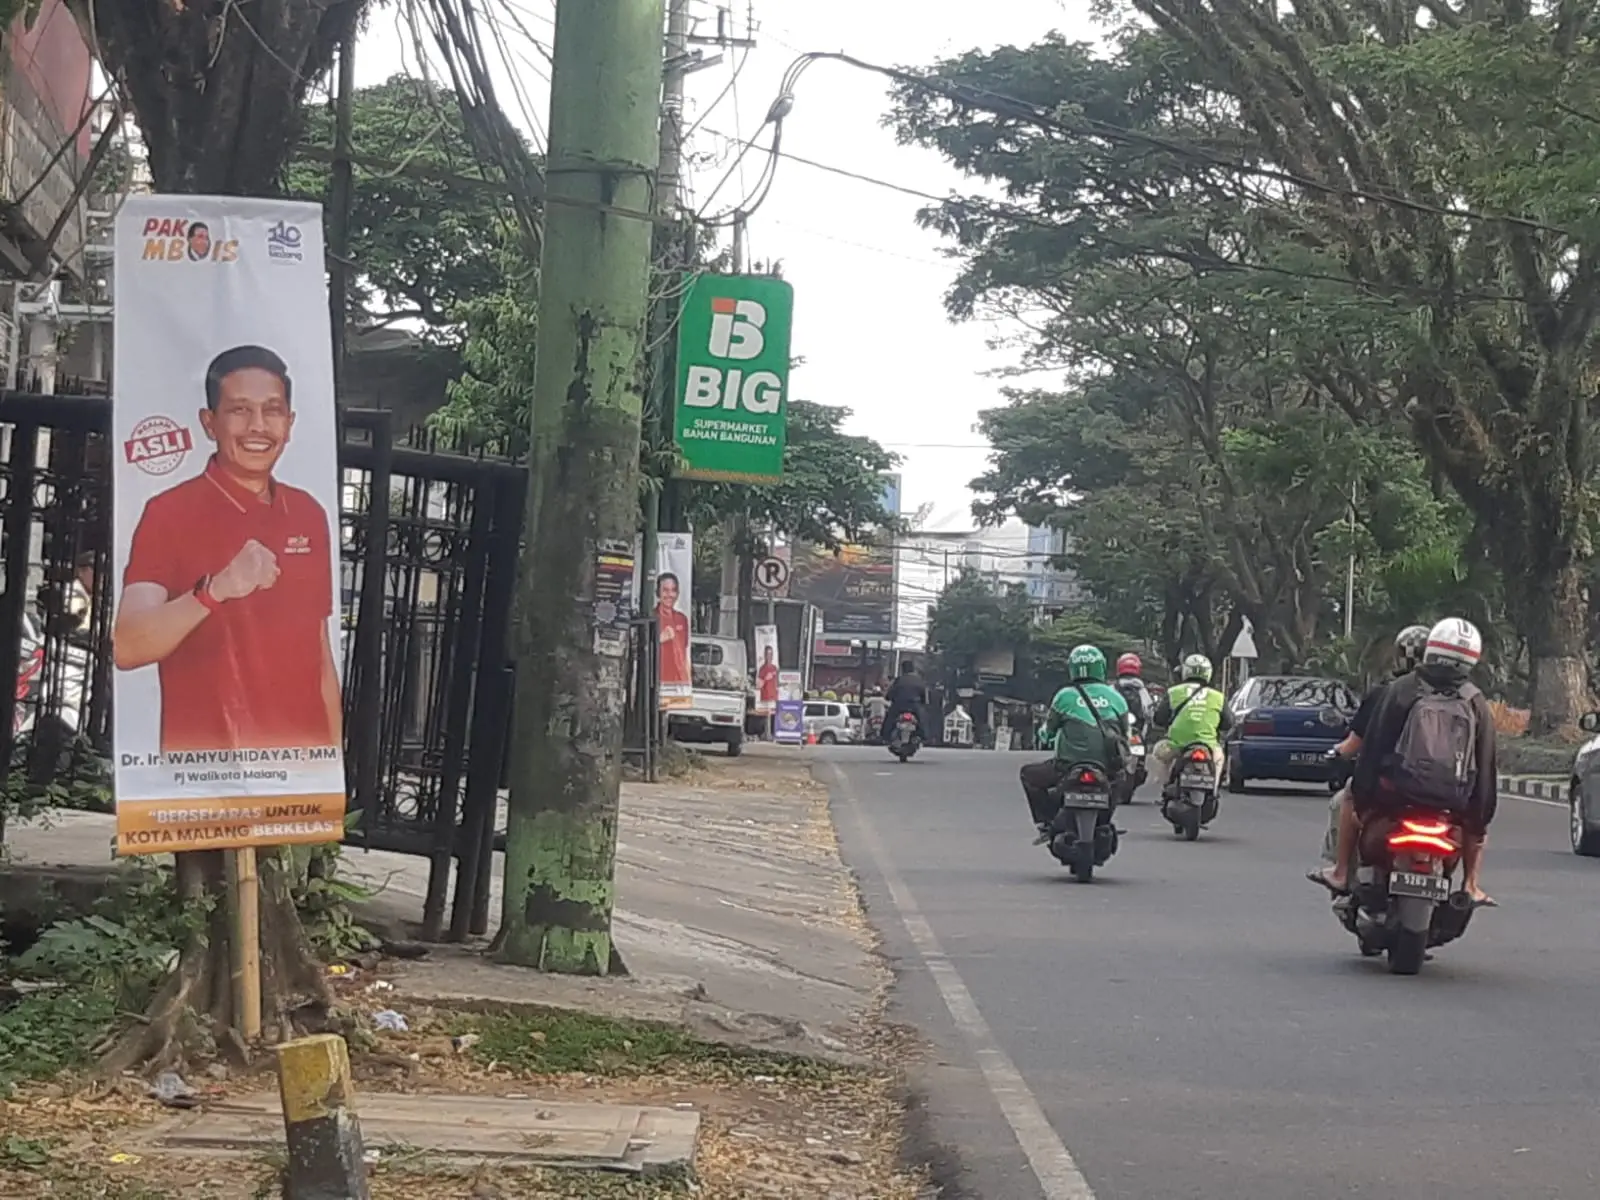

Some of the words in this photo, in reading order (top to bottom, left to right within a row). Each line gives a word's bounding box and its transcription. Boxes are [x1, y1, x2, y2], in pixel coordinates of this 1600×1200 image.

[142, 217, 189, 236] PAK
[684, 366, 782, 414] BIG
[694, 418, 769, 434] SUPERMARKET
[130, 431, 186, 461] ASLI
[683, 427, 718, 441] BAHAN
[719, 430, 777, 446] BANGUNAN
[1075, 694, 1109, 708] Gab
[121, 753, 145, 767] Dr.
[148, 753, 165, 766] Ir.
[167, 751, 230, 765] WAHYU
[232, 748, 306, 763] HIDAYAT,
[308, 747, 337, 760] MM
[174, 772, 185, 785] Pj
[187, 770, 241, 782] Walikota
[243, 769, 288, 781] Malang
[266, 803, 321, 817] UNTUK
[125, 829, 173, 845] KOTA
[177, 824, 250, 841] MALANG
